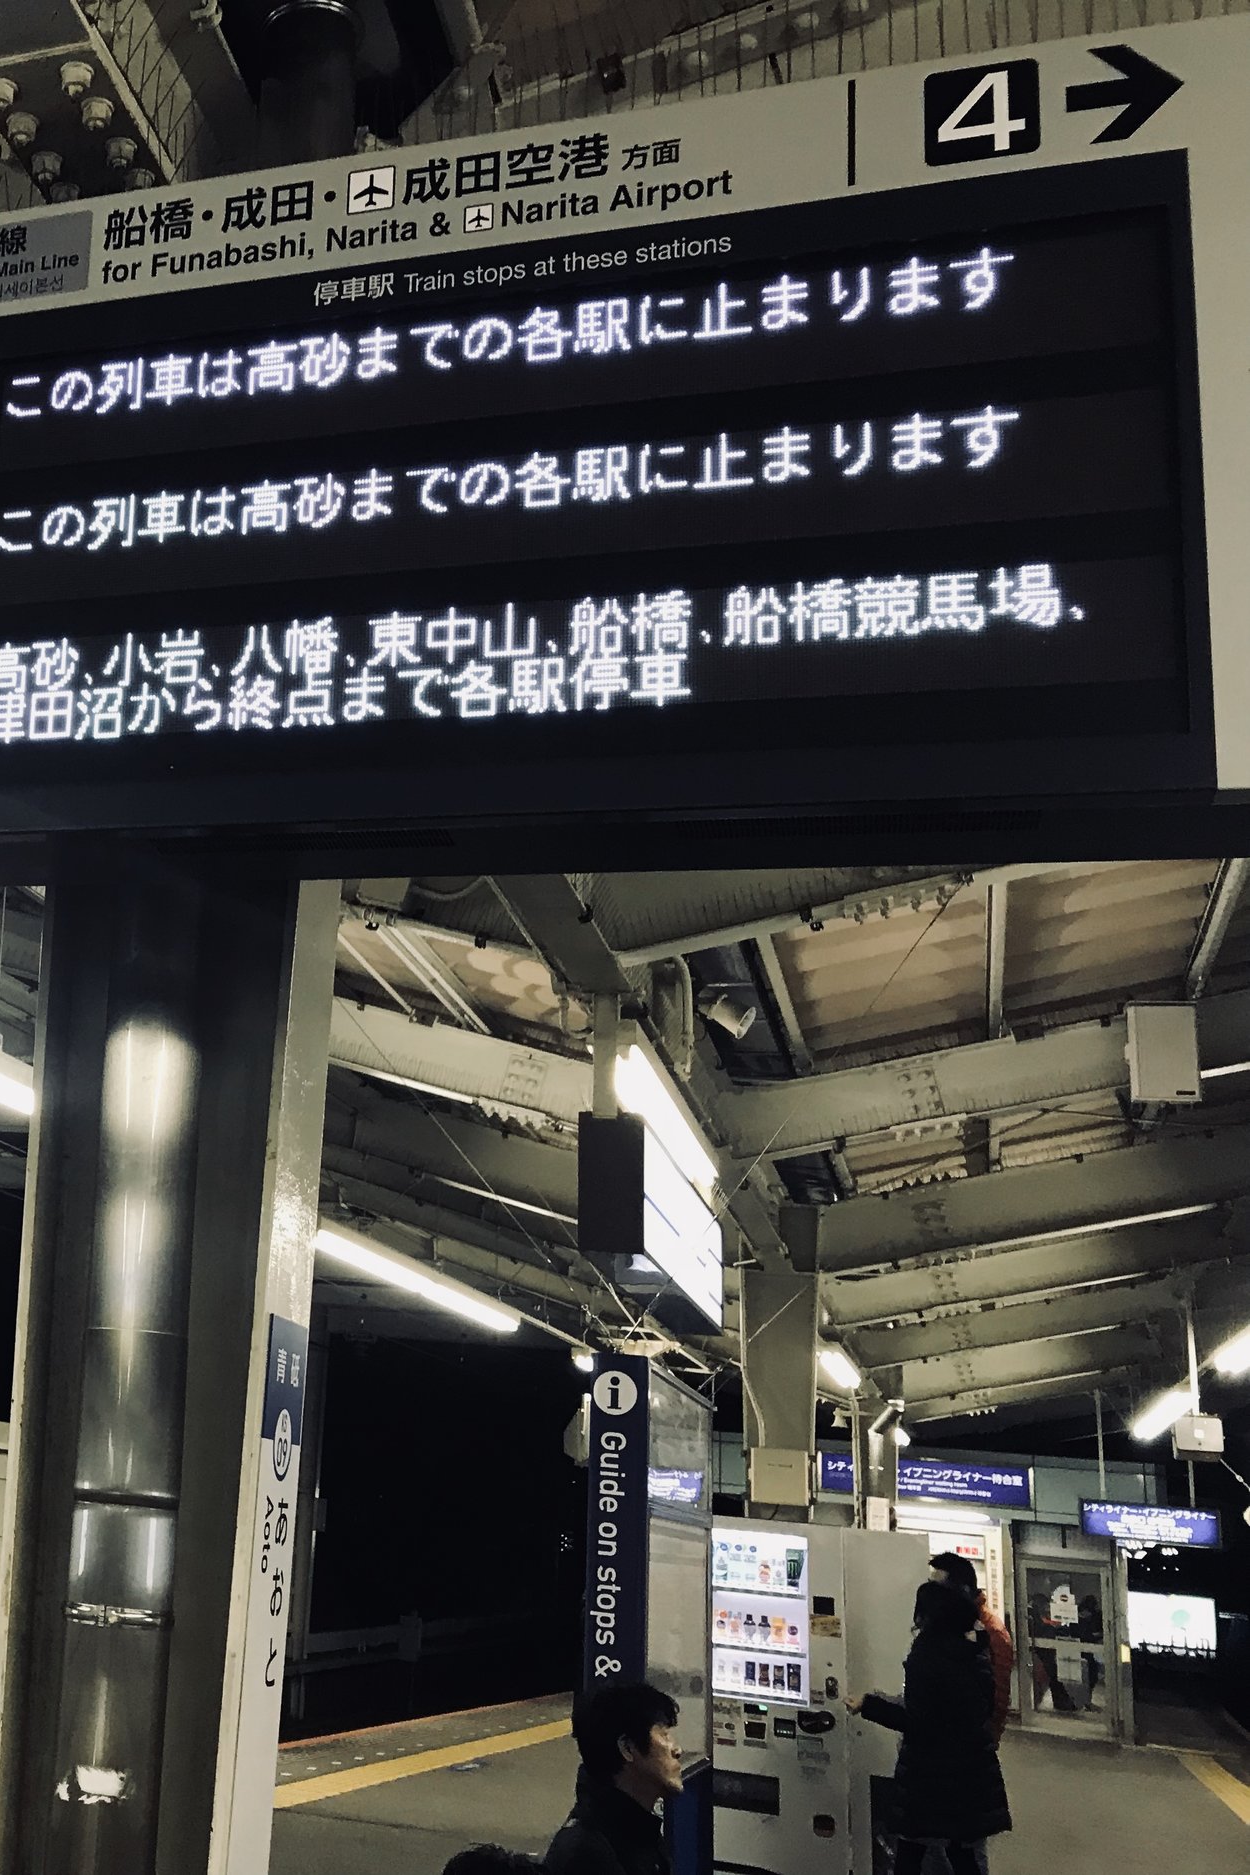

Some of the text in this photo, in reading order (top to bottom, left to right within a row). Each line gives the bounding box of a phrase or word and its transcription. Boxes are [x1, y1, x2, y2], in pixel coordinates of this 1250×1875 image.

[937, 70, 1027, 153] 4
[402, 132, 610, 205] 成田空港
[622, 138, 681, 171] 方面
[41, 254, 80, 271] Line
[102, 169, 733, 284] for Funabashi, Narita & Narita Airport
[404, 235, 732, 293] Train stops at these stations
[313, 272, 394, 306] 停車駅
[6, 248, 1015, 417] この列車は高砂までの各駅に止まります
[277, 1437, 289, 1468] 09
[261, 1495, 275, 1573] Aoto
[589, 1431, 627, 1678] Guide on stops &
[265, 1498, 289, 1688] あおと
